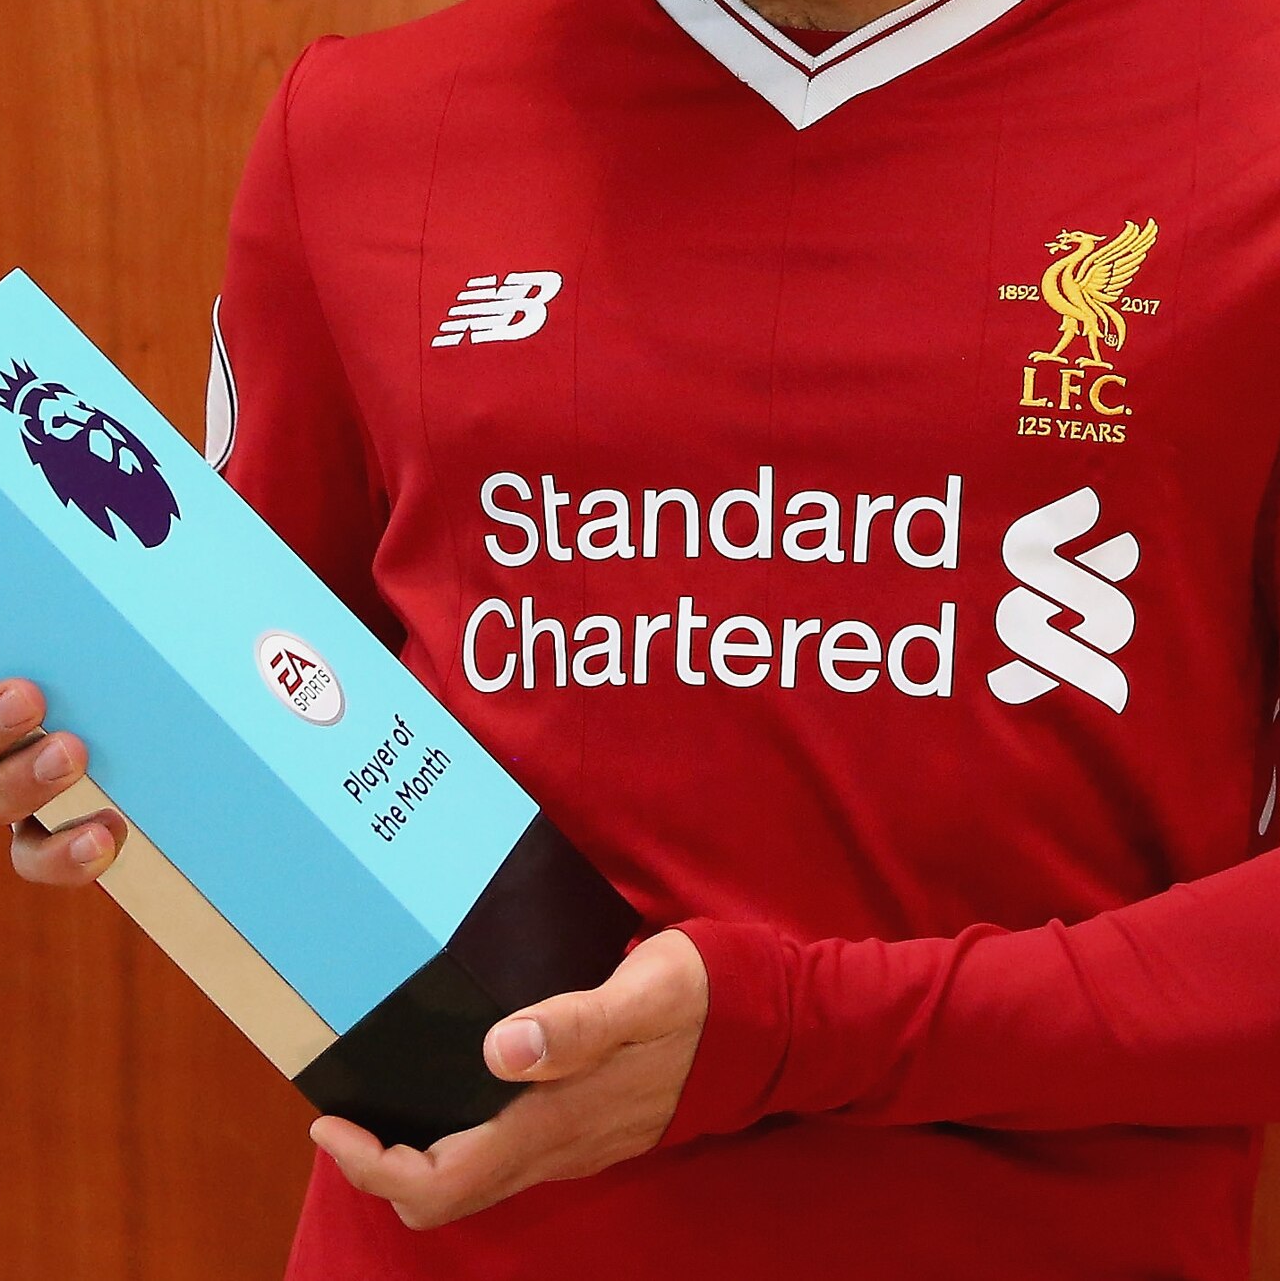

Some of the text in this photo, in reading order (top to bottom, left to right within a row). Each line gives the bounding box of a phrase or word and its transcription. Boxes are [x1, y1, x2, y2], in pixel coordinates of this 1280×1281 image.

[997, 284, 1040, 301] 1892
[1120, 296, 1161, 316] 2017
[1019, 366, 1133, 416] L.F.C.
[1017, 416, 1127, 444] 125 YEARS
[479, 465, 962, 570] Standard
[462, 596, 956, 698] Chartered
[270, 648, 317, 697] EA
[293, 668, 331, 712] SPORTS
[343, 713, 415, 804] Player of
[370, 746, 452, 843] the Month
